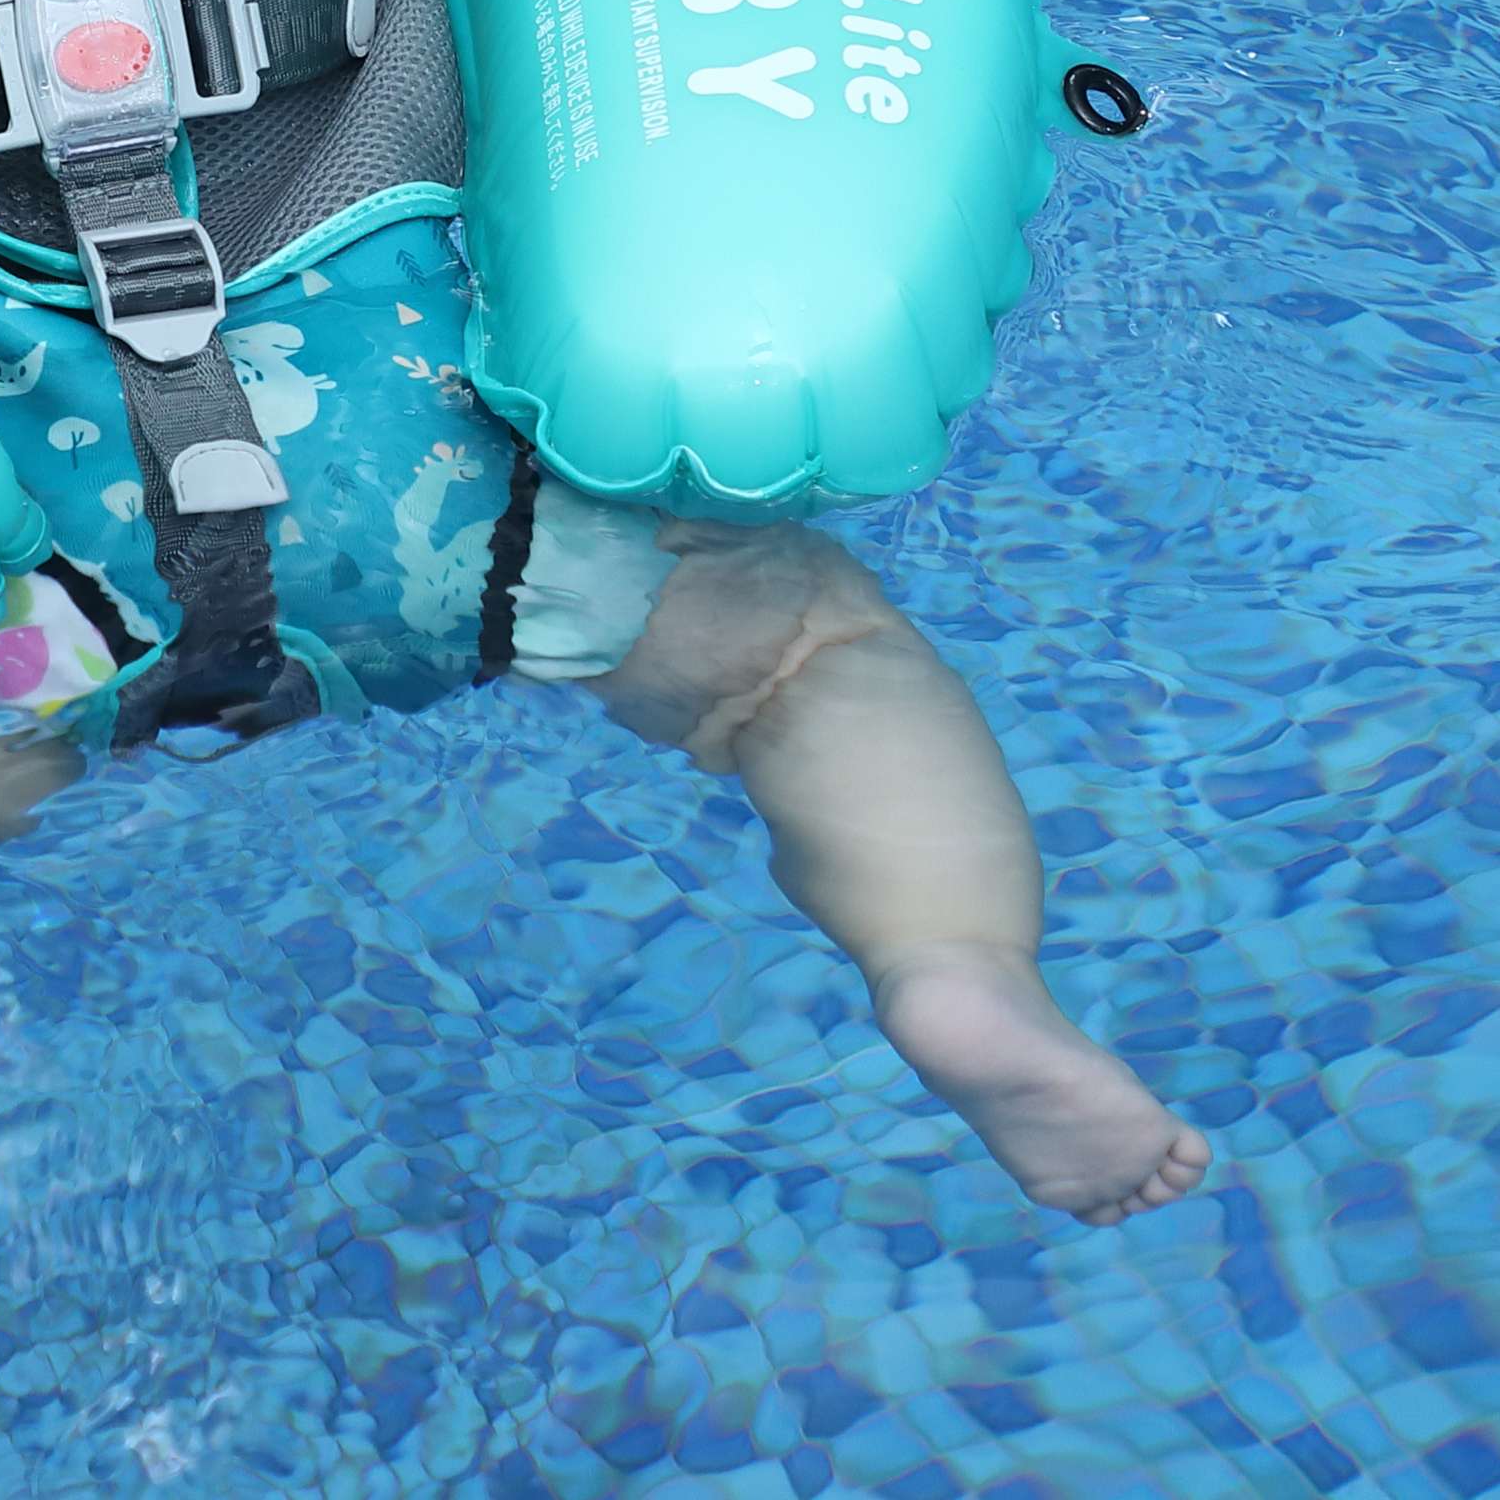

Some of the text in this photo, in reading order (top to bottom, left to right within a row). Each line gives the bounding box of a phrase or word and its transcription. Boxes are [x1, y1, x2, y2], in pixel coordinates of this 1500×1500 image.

[559, 7, 585, 52] WHILE
[563, 50, 590, 106] DEVICE
[632, 34, 670, 145] SUPERVISION.
[569, 101, 593, 119] IS
[570, 115, 595, 136] IN
[572, 129, 598, 171] USE.
